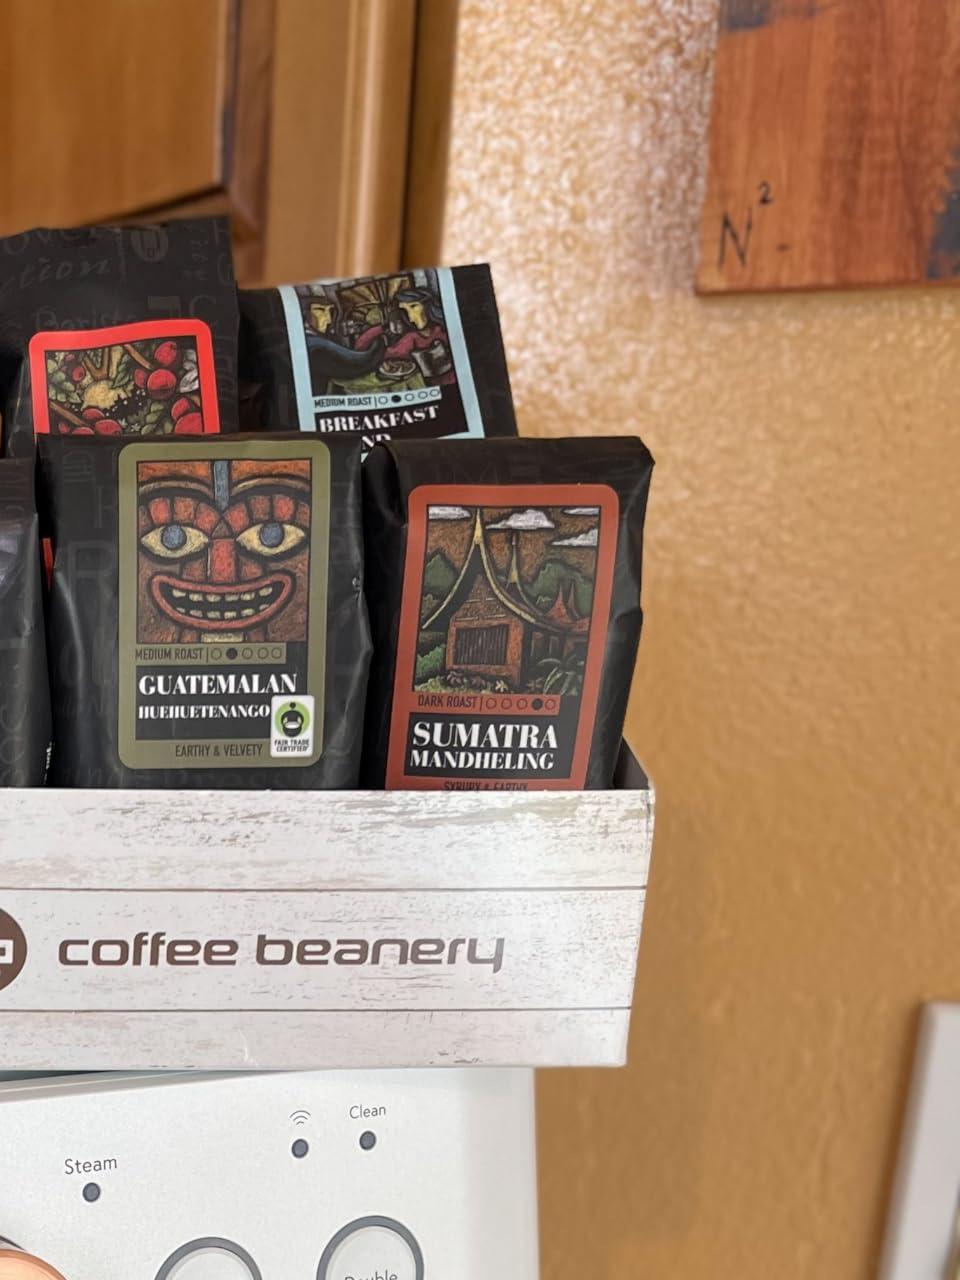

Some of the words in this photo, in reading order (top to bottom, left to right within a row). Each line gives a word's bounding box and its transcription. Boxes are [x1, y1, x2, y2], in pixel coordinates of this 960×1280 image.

[314, 398, 345, 409] MEDIUM
[347, 396, 372, 406] ROAST
[319, 405, 439, 433] BREAKFAST
[135, 648, 172, 661] MEDIUM
[174, 647, 203, 660] ROAST
[138, 673, 298, 696] GUATEMALAN
[417, 694, 445, 708] DARK
[446, 695, 478, 709] ROAST
[138, 704, 271, 720] HUEHUETENANGO
[412, 721, 559, 749] SUMATRA
[175, 744, 211, 758] EARTHY
[213, 745, 220, 757] &
[223, 743, 263, 757] VELVETY
[410, 749, 555, 771] MANDHELING
[58, 931, 239, 966] coffee
[255, 934, 505, 974] beanery
[349, 1104, 387, 1120] Clean
[64, 1157, 118, 1175] Steam
